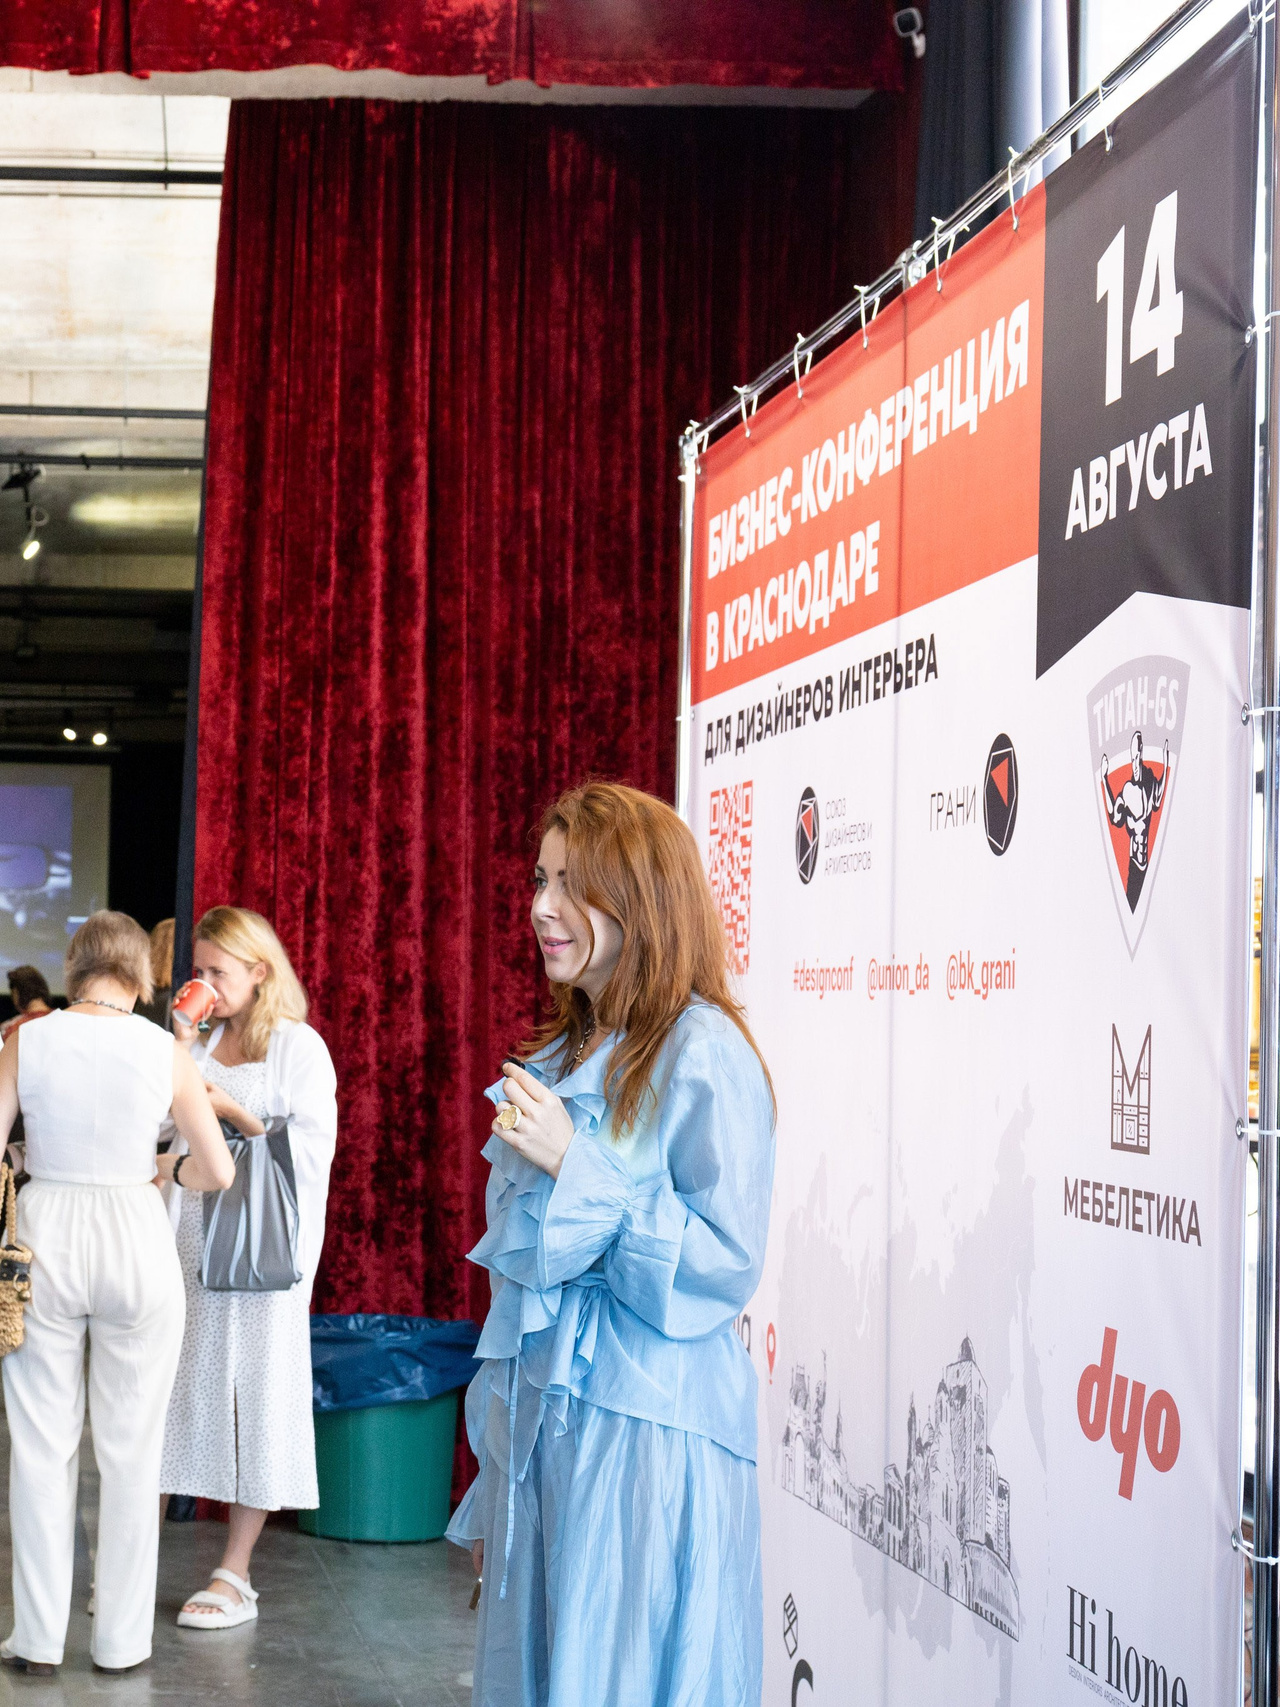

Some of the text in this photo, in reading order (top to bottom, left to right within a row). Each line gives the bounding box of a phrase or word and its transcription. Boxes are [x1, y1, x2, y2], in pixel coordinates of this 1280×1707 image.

[1096, 190, 1183, 406] 14
[707, 298, 1029, 580] БИЗНЕС-КОНФЕРЕНЦИЯ
[1065, 402, 1213, 541] АВГУСТА
[705, 520, 881, 672] В КРАСНОДАРЕ
[704, 633, 939, 767] ДЛЯ ДИЗАЙНЕРОВ ИНТЕРЬЕРА
[1093, 675, 1180, 748] ТИТАН-GS
[824, 822, 867, 850] ДИЗАЙНЕРОВ
[825, 797, 847, 821] СОЮЗ
[929, 784, 977, 832] ГРАНИ
[824, 851, 872, 877] АРХИТЕКТОРОВ
[793, 947, 1016, 1001] #designconf @union_da @bk_grani
[1064, 1176, 1202, 1247] МЕБЕЛЕТИКА
[1077, 1326, 1181, 1501] dyo
[1066, 1585, 1188, 1707] Hi home
